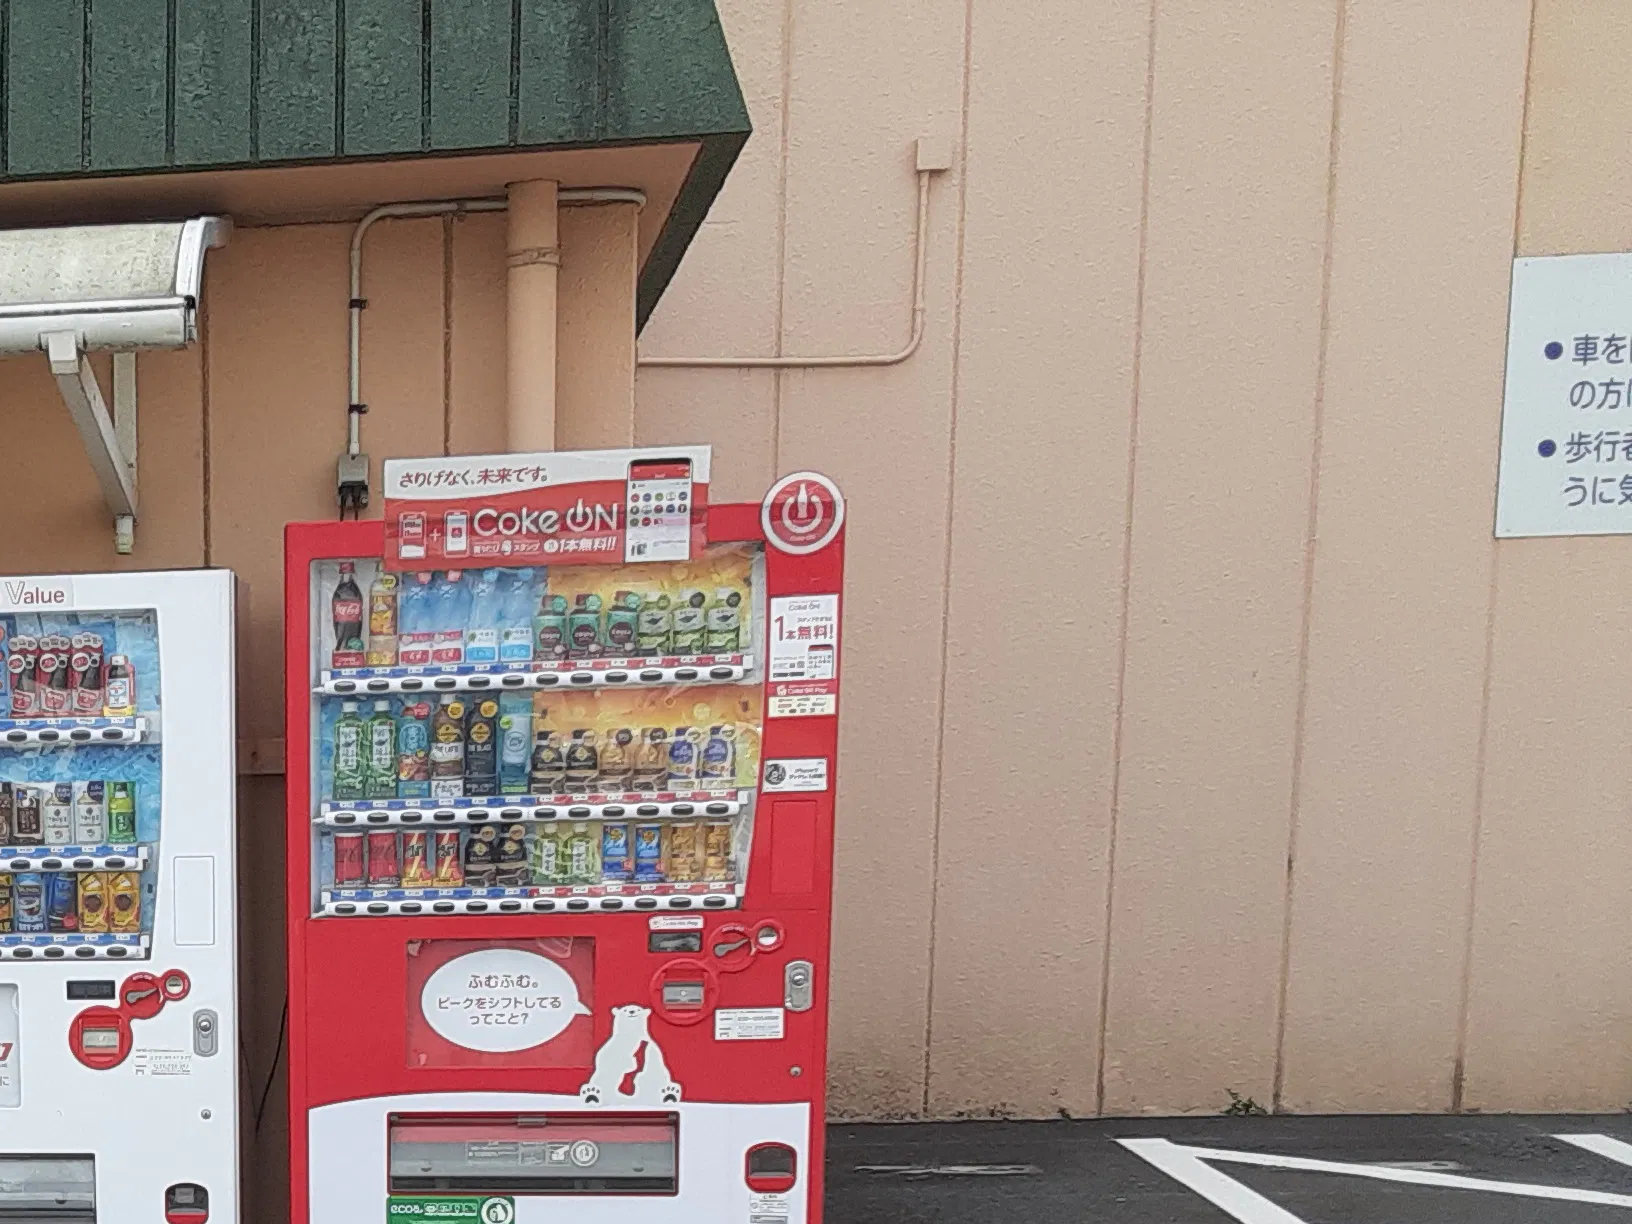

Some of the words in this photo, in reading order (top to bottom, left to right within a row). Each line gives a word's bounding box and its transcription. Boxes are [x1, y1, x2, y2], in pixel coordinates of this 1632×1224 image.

[1572, 334, 1632, 366] 車を
[1570, 377, 1632, 410] の方
[399, 465, 548, 489] さりげなく、未来です。
[473, 506, 561, 536] Coke
[4, 580, 65, 605] Value
[468, 974, 539, 989] ふむふむ。
